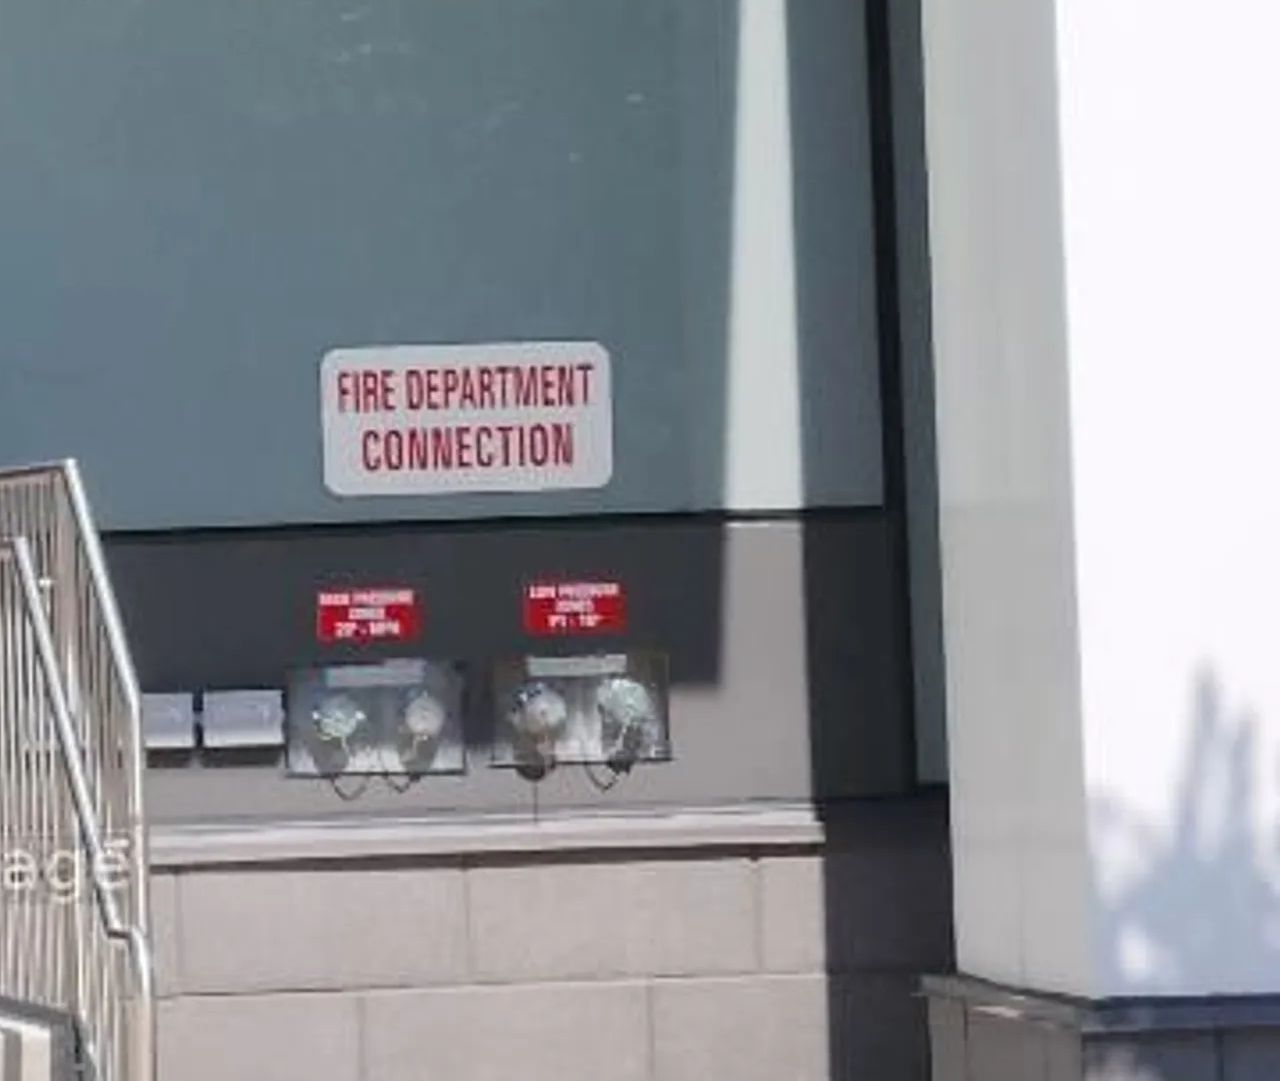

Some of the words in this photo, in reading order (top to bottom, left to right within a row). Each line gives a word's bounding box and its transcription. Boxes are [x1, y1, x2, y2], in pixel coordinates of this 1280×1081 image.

[337, 369, 396, 414] FIRE
[405, 363, 595, 411] DEPARTMENT
[361, 422, 575, 472] CONNECTION
